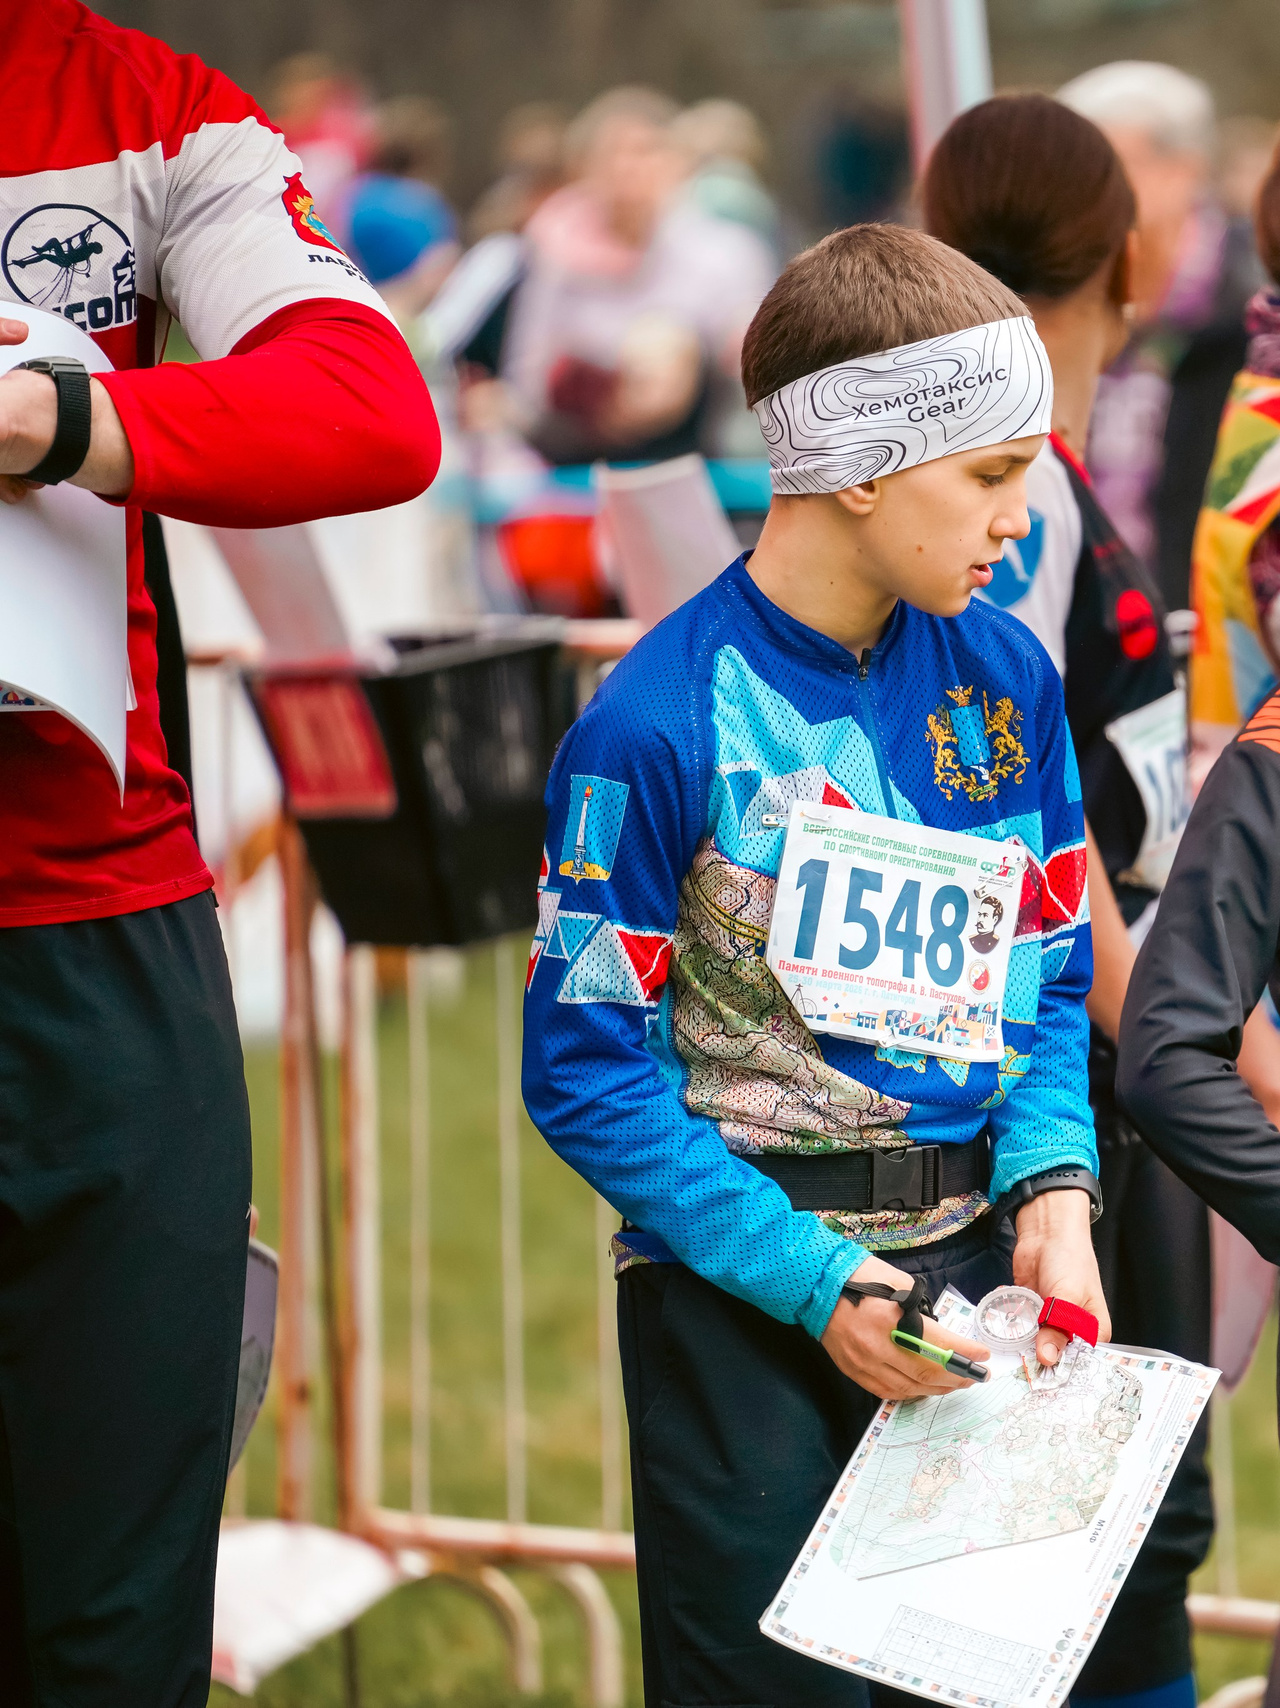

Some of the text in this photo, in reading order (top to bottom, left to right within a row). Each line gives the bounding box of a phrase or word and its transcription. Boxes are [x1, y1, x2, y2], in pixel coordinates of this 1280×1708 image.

[907, 396, 966, 423] Gear
[802, 822, 978, 867] ВСЕРОССИЙСКИЕ СПОРТИВНЫЕ СОРЕВНОВАНИЯ
[823, 840, 956, 877] ПО СПОРТИВНОМУ ОРИЕНТИРОВАНИЮ
[794, 858, 969, 988] 1548
[778, 960, 966, 1005] Памяти военного топографа А. В. Пастухова
[816, 979, 842, 993] марта
[1087, 1517, 1105, 1544] М14Ф
